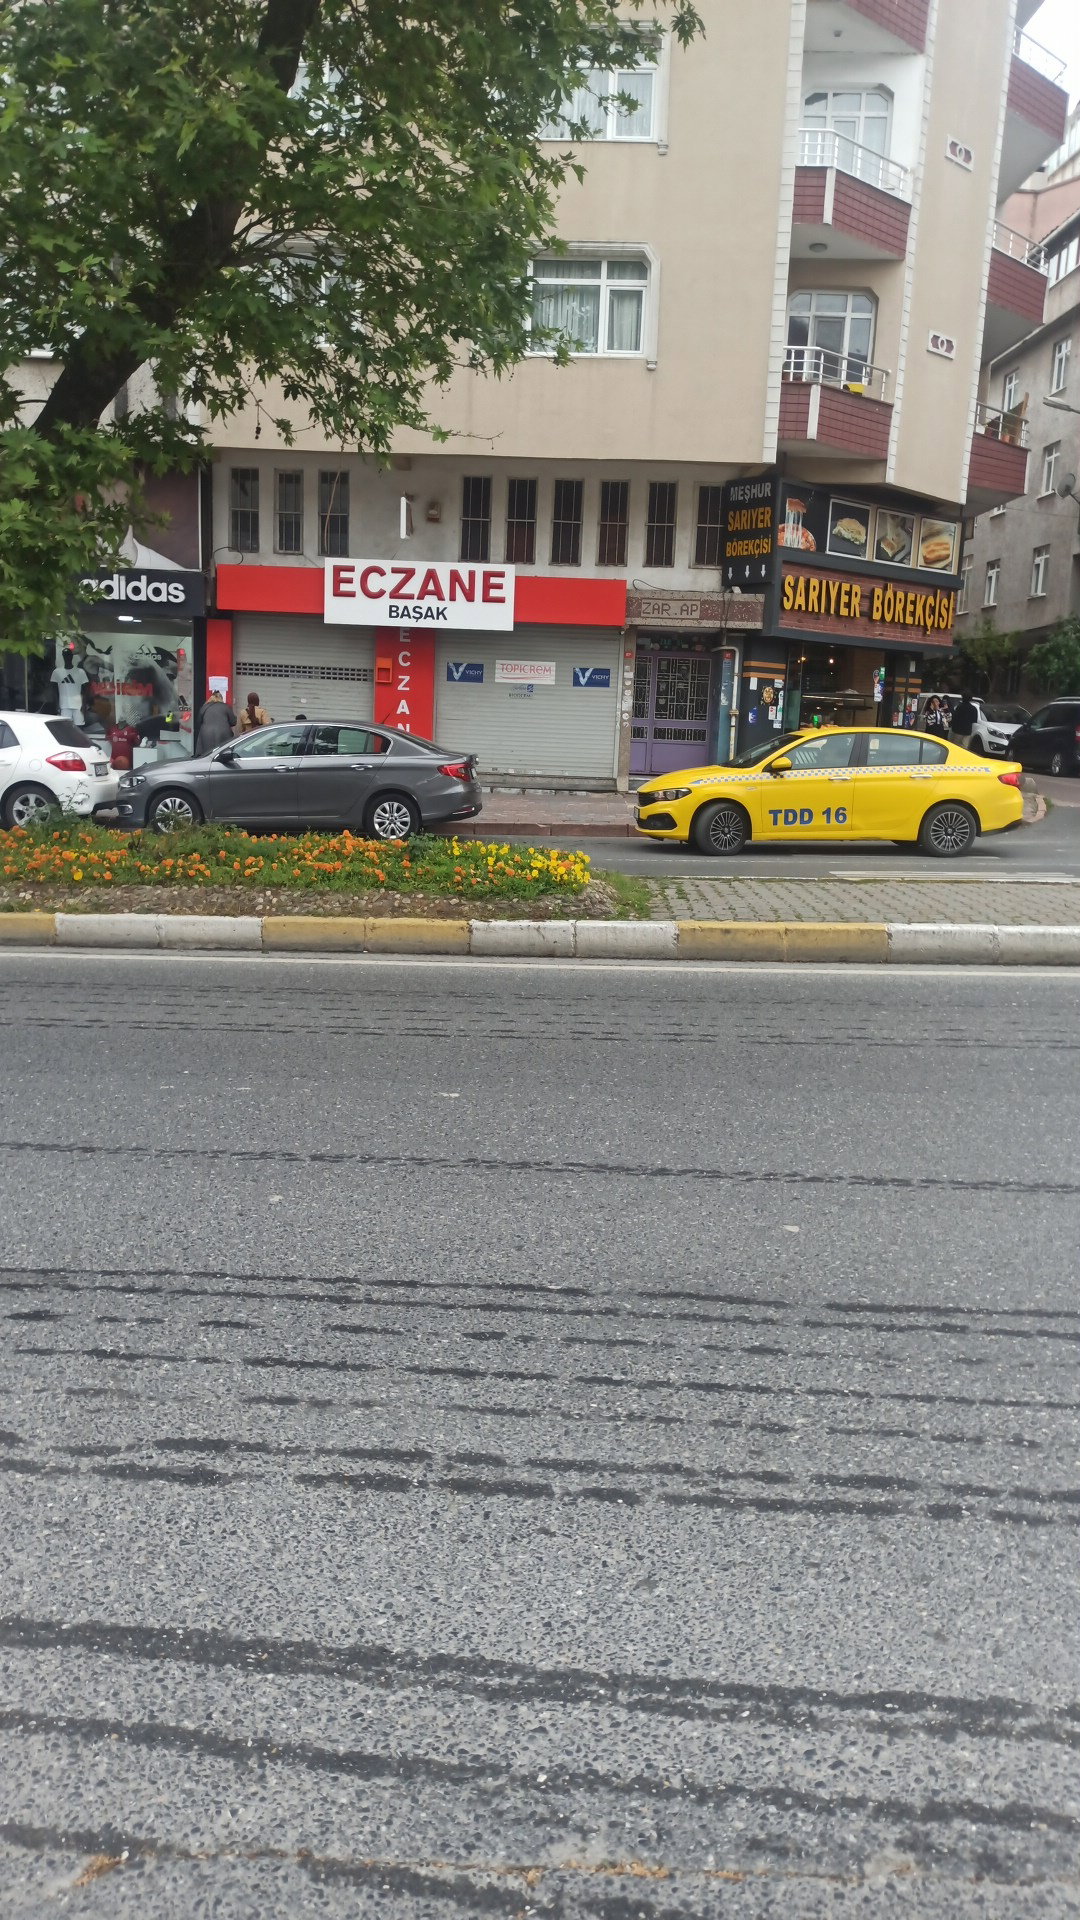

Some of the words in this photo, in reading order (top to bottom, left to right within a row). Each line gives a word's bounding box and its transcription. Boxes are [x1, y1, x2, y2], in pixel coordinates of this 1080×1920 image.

[730, 482, 771, 503] MEŞHUR
[728, 507, 772, 532] SARIYER
[726, 534, 772, 558] BÖREKÇİSİ
[79, 573, 186, 603] adidas
[332, 564, 506, 604] ECZANE
[388, 605, 448, 623] BAŞAK
[783, 574, 862, 618] SARIYER
[872, 582, 955, 635] BÖREKÇİSİ
[768, 808, 814, 826] TDD
[822, 806, 847, 824] 16
